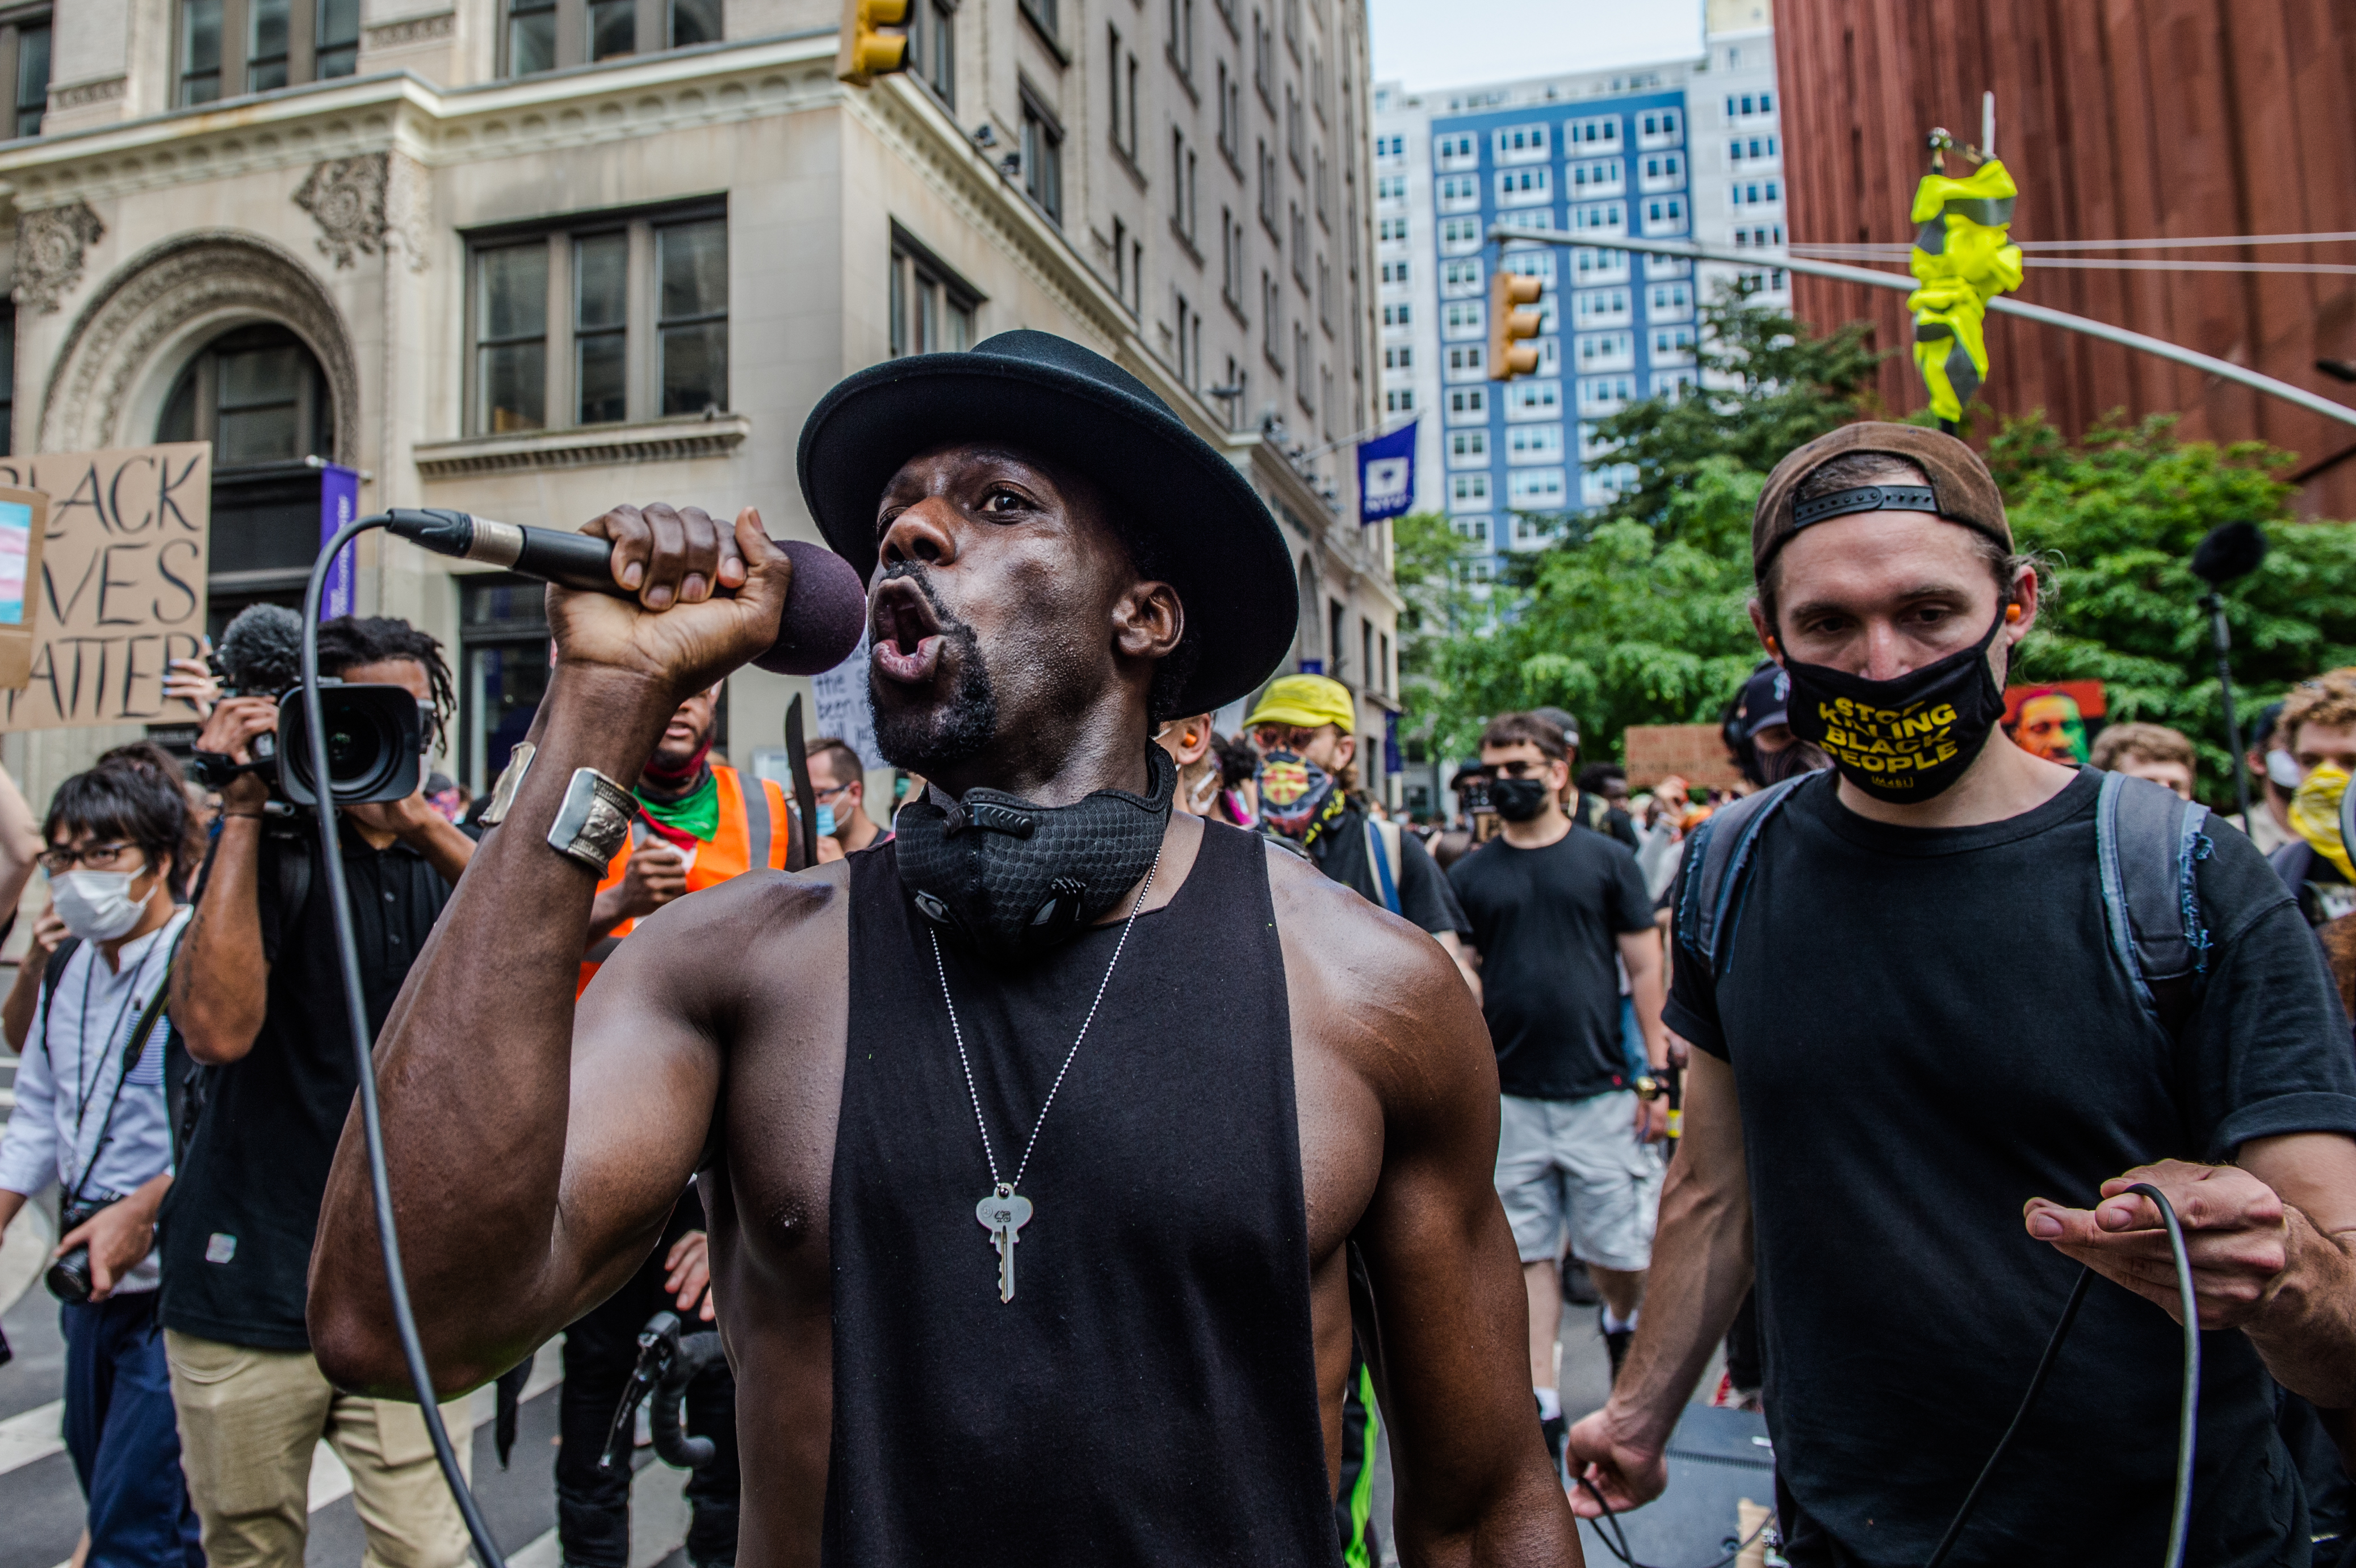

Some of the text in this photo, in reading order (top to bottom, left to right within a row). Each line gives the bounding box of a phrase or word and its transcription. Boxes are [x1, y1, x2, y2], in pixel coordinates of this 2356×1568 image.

[0, 454, 202, 539] ACK
[41, 537, 199, 626] VES
[0, 631, 201, 722] ATTER
[1825, 724, 1952, 756] BLACK
